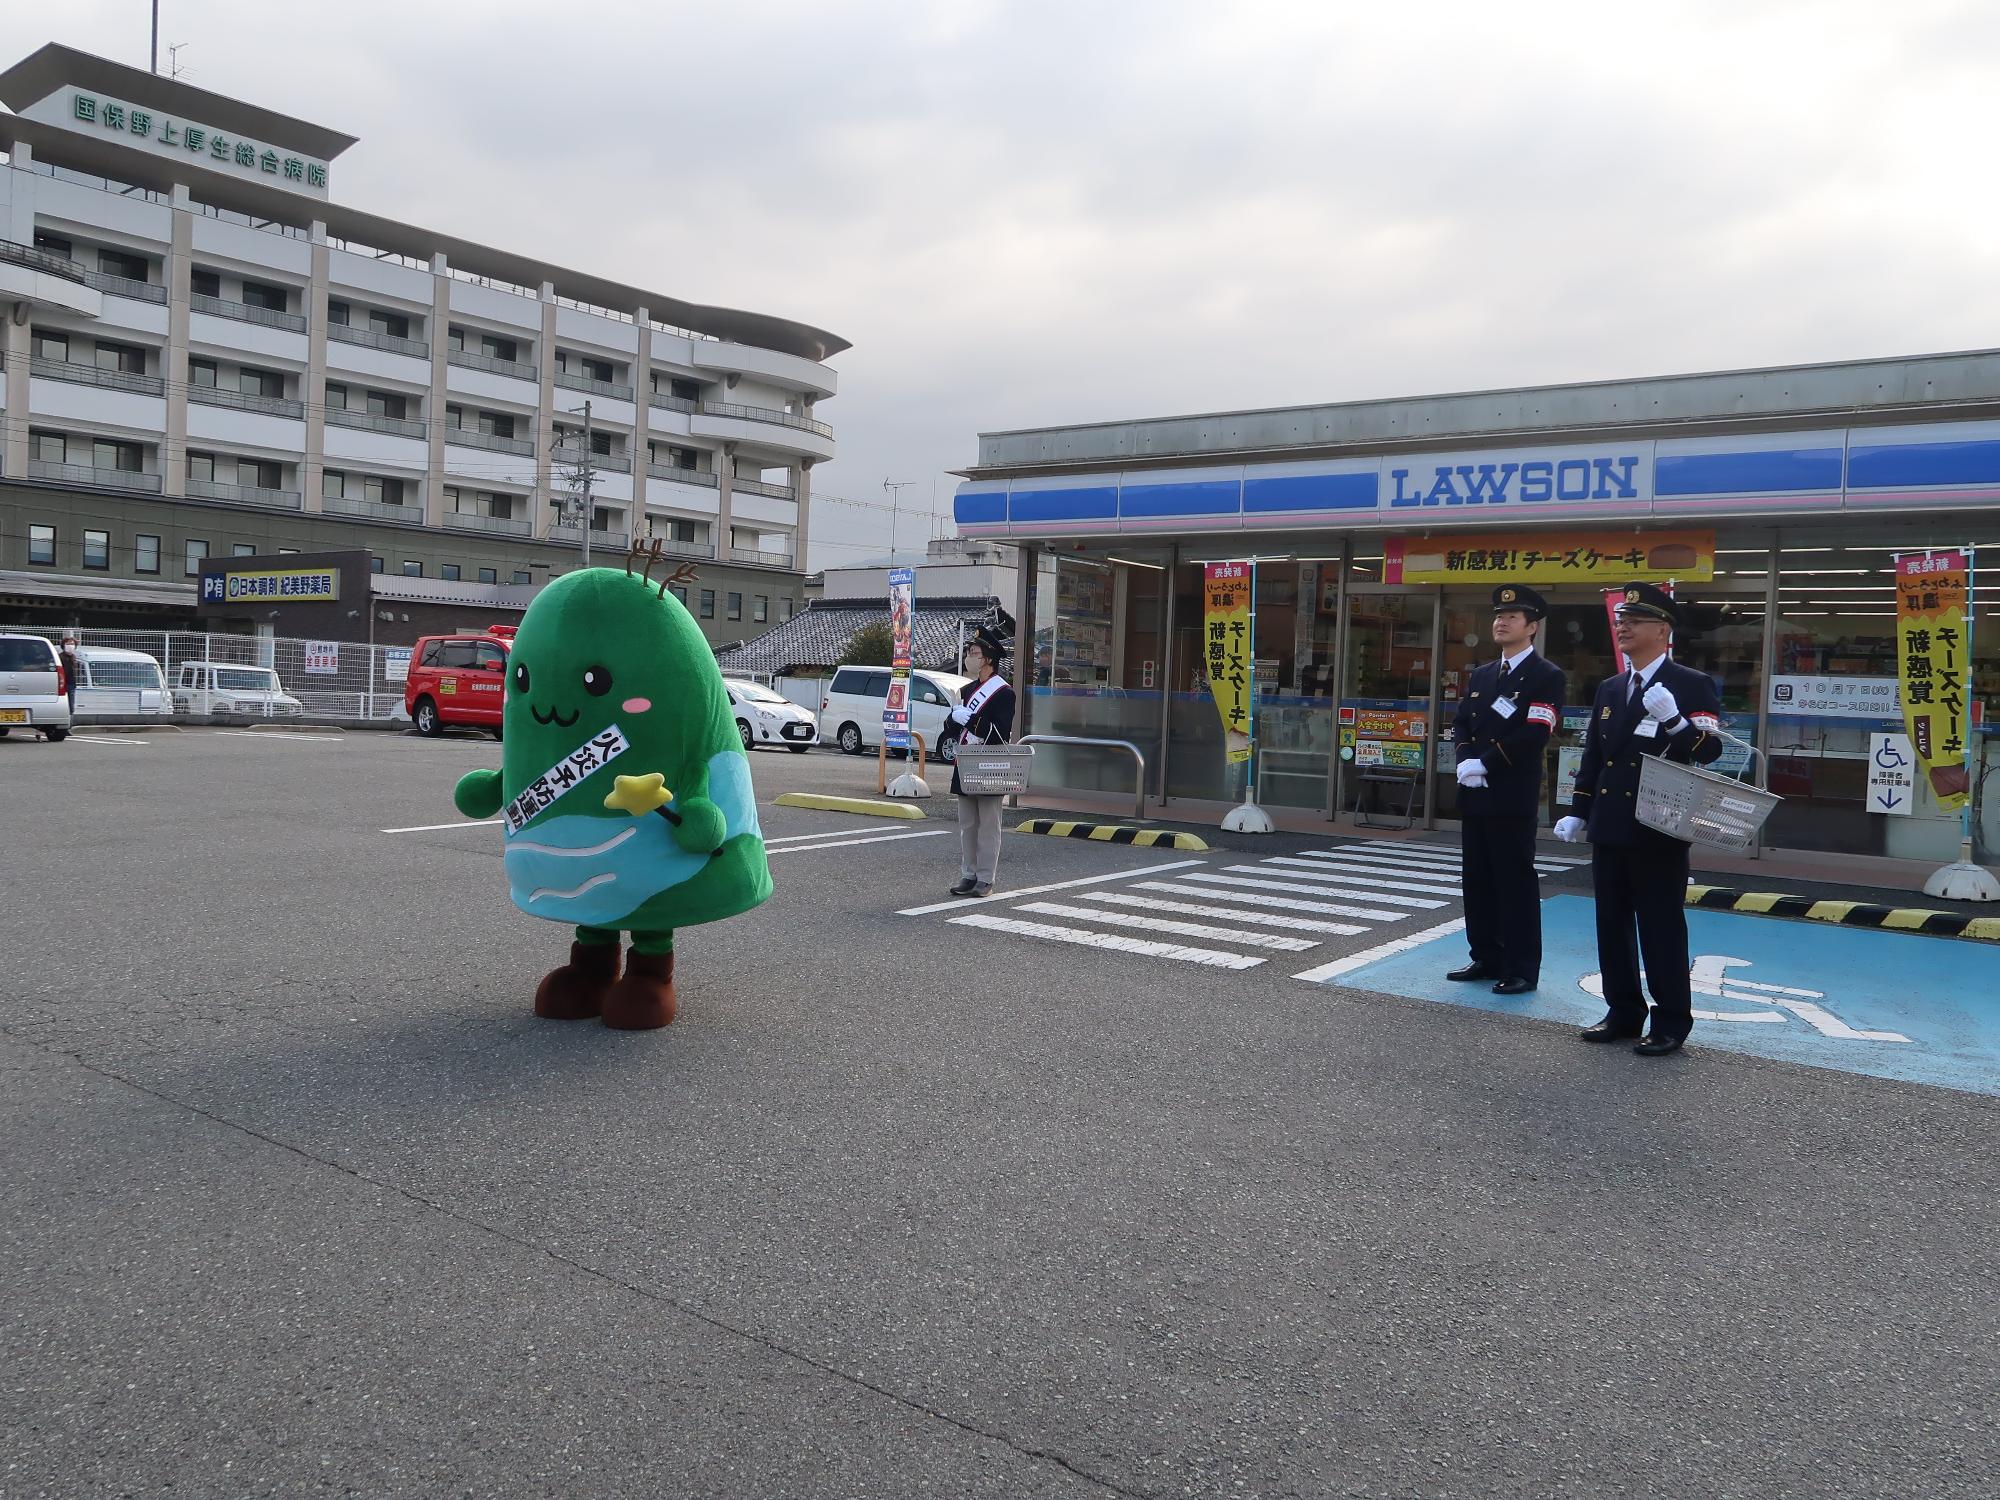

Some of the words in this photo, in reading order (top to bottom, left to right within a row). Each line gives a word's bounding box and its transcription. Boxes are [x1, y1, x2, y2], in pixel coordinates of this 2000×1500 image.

[75, 94, 327, 188] 国保野上厚生総合病院
[1391, 456, 1640, 508] LAWSON
[239, 576, 278, 596] 日本調剤
[280, 575, 332, 596] 紀美野薬局
[506, 732, 622, 830] 火災予防運動
